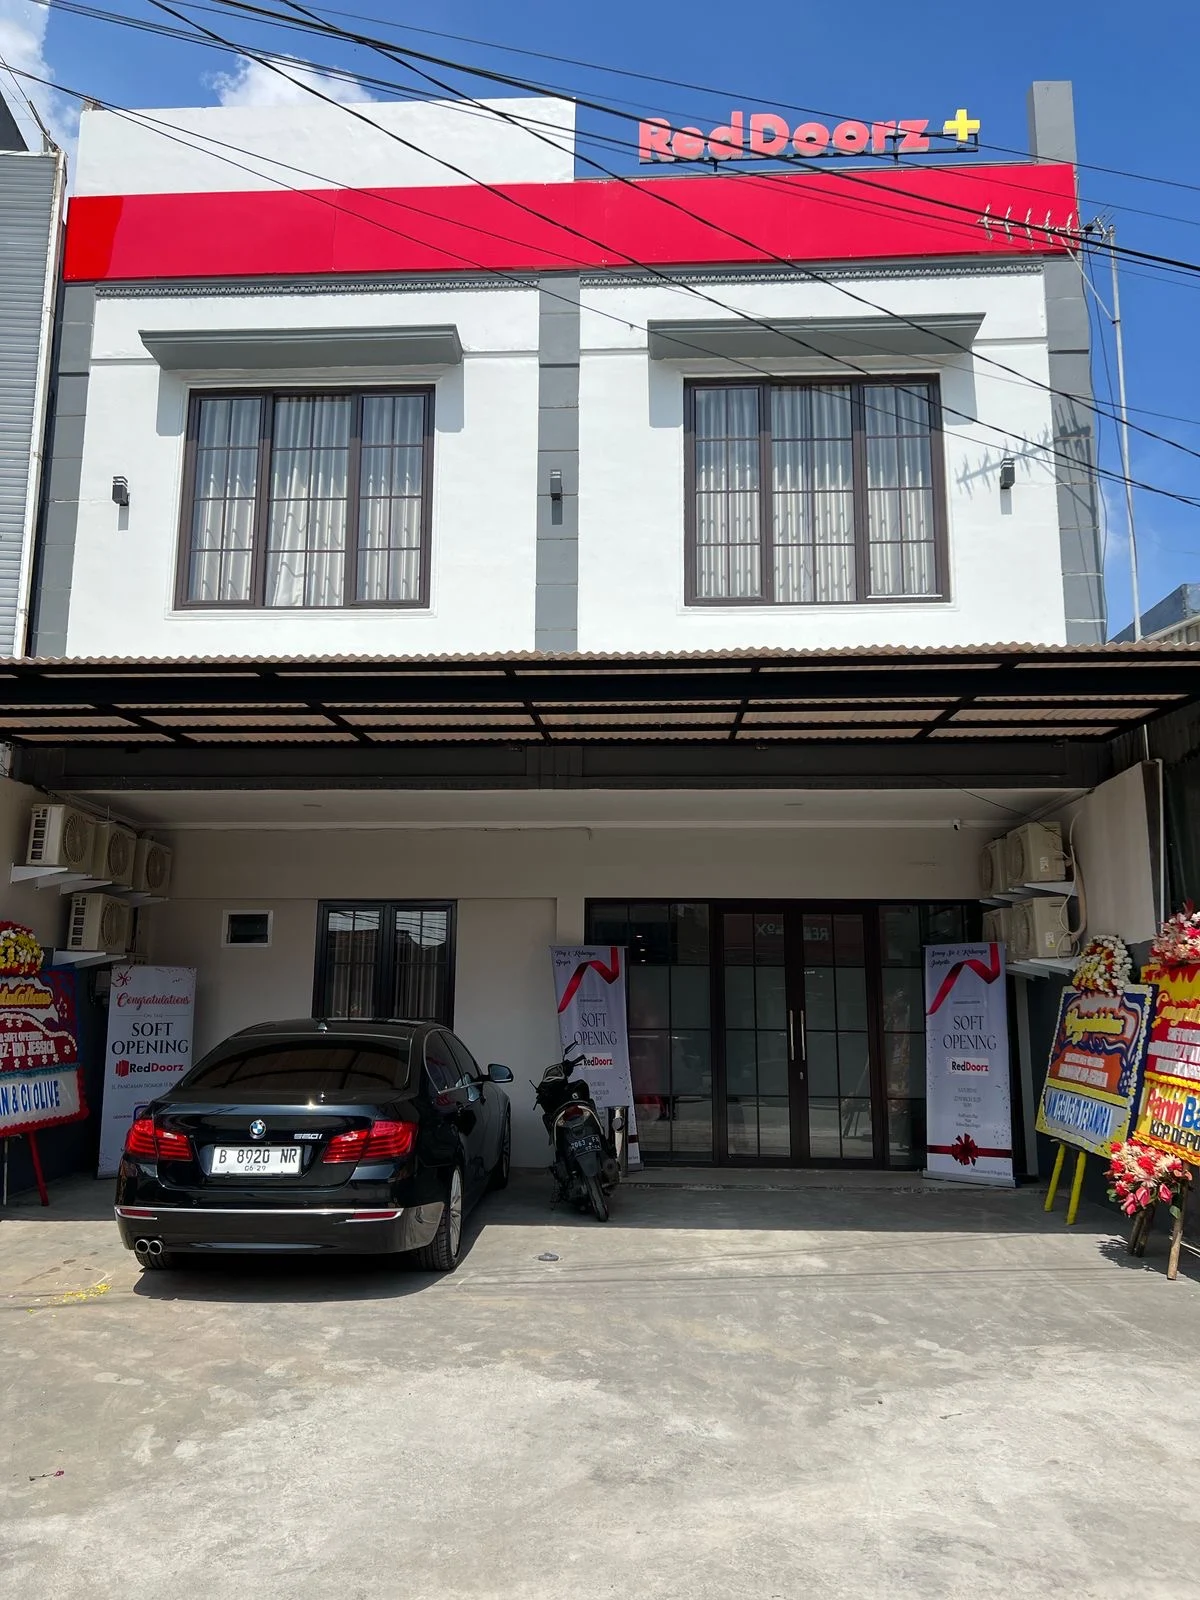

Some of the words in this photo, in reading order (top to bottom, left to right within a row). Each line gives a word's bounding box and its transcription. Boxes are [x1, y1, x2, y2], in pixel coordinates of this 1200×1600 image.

[639, 111, 930, 161] RedDoorz
[117, 992, 191, 1010] Congratulations
[581, 1012, 606, 1027] SOFT
[953, 1015, 984, 1031] SOFT
[131, 1022, 173, 1037] SOFT
[574, 1030, 618, 1046] OPENING
[943, 1033, 997, 1050] OPENING
[111, 1040, 189, 1055] OPENING
[129, 1062, 184, 1073] RedDoorz
[951, 1060, 989, 1072] RedDoorz
[12, 1085, 19, 1114] &
[20, 1083, 32, 1112] CI
[33, 1080, 61, 1110] OLIVE
[218, 1149, 228, 1164] B
[236, 1149, 271, 1164] 8920
[280, 1148, 298, 1164] NR
